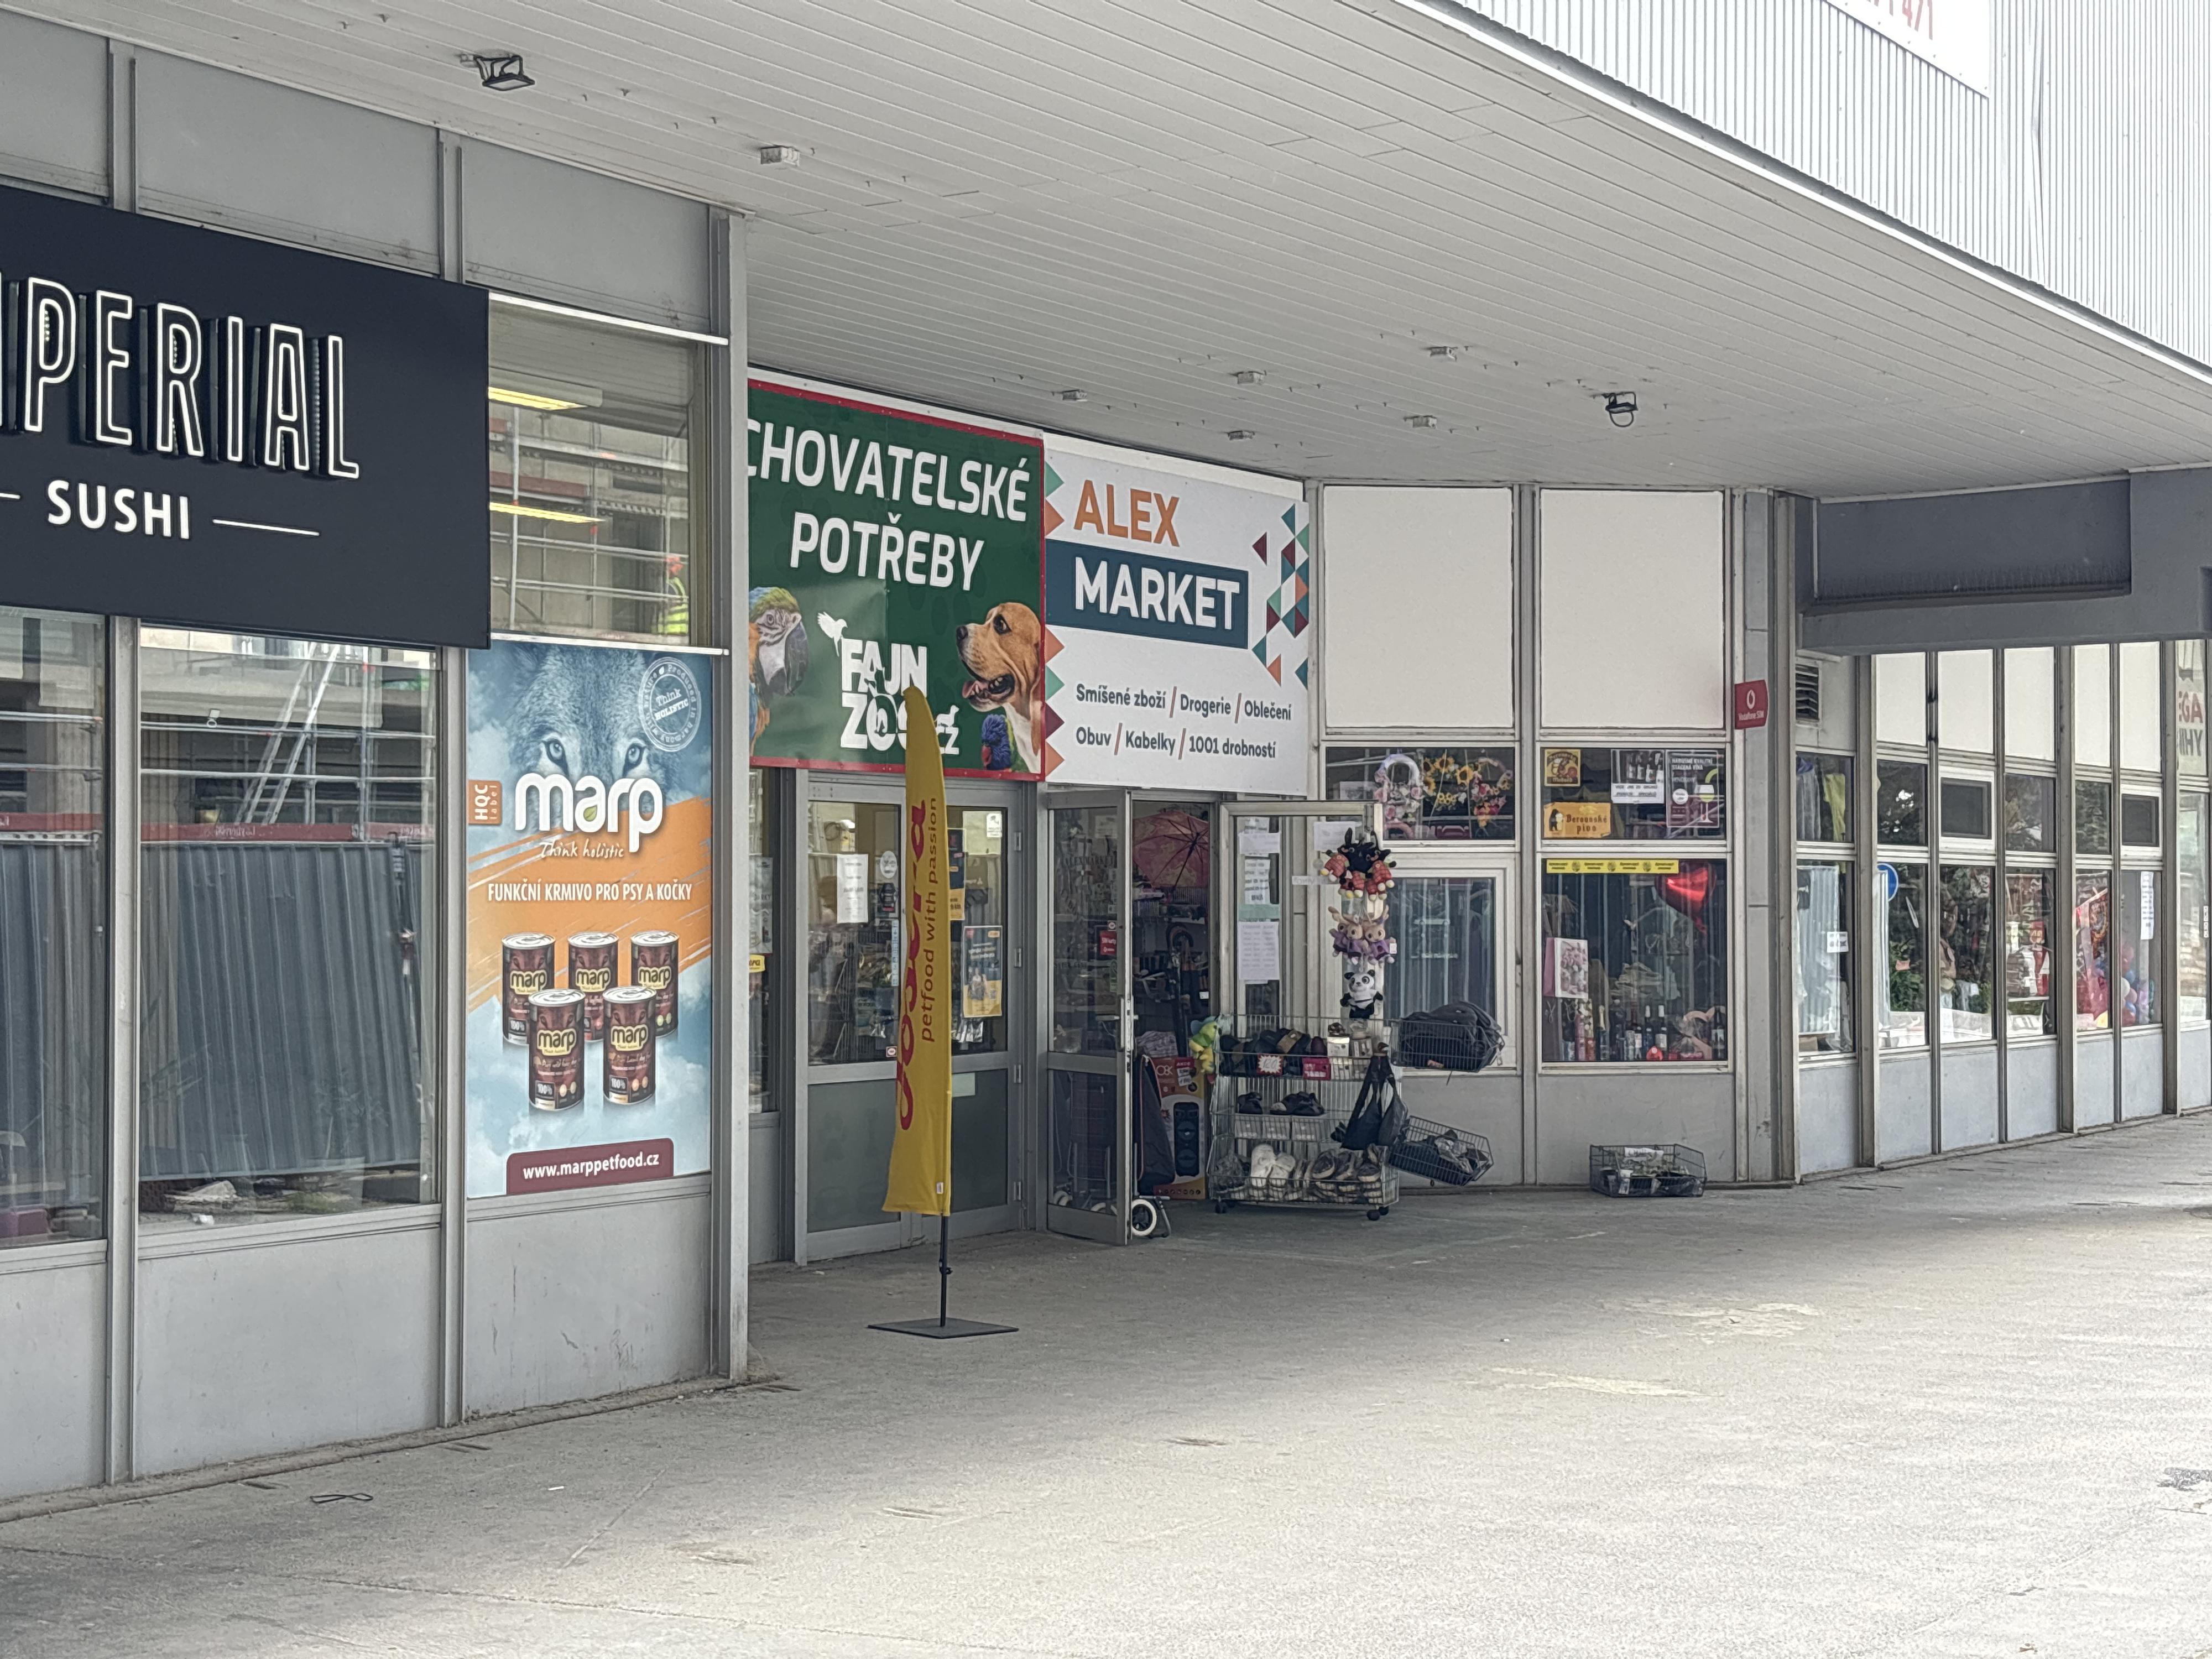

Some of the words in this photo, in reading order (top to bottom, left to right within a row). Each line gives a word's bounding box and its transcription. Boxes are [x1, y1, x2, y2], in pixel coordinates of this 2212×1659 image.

[0, 272, 359, 479] PERIAL
[46, 479, 191, 540] SUSHI
[1073, 479, 1180, 547] ALEX
[790, 511, 985, 591] POTŘEBY
[1075, 557, 1240, 630] MARKET
[841, 637, 927, 697] FAJN
[655, 698, 689, 721] HOLISTIC
[656, 688, 681, 706] Think
[1076, 683, 1130, 706] Smíšené
[1134, 691, 1166, 710] zboží
[1180, 694, 1231, 717] Drogerie
[1244, 700, 1291, 721] Oblečení
[1076, 727, 1111, 747] Obuv
[1125, 731, 1176, 755] Kabelky
[1189, 735, 1220, 754] 1001
[1222, 739, 1276, 758] drobností
[475, 784, 491, 820] HQC
[489, 785, 498, 819] label
[514, 772, 664, 853] marp
[926, 798, 938, 885] passion
[1577, 823, 1597, 834] pivo
[540, 840, 578, 858] Think
[582, 838, 624, 858] holistic
[488, 878, 541, 902] FUNKČNÍ
[545, 883, 592, 901] KRMIVO
[596, 883, 619, 901] PRO
[622, 883, 645, 901] PSY
[645, 884, 654, 900] A
[656, 879, 692, 900] KOČKY
[924, 891, 937, 941] with
[511, 971, 546, 990] marp
[577, 969, 610, 988] marp
[639, 967, 671, 987] marp
[919, 950, 935, 1042] petfood
[539, 1031, 576, 1051] marp
[612, 1027, 647, 1048] marp
[523, 1152, 659, 1180] www.marppetfood.cz
